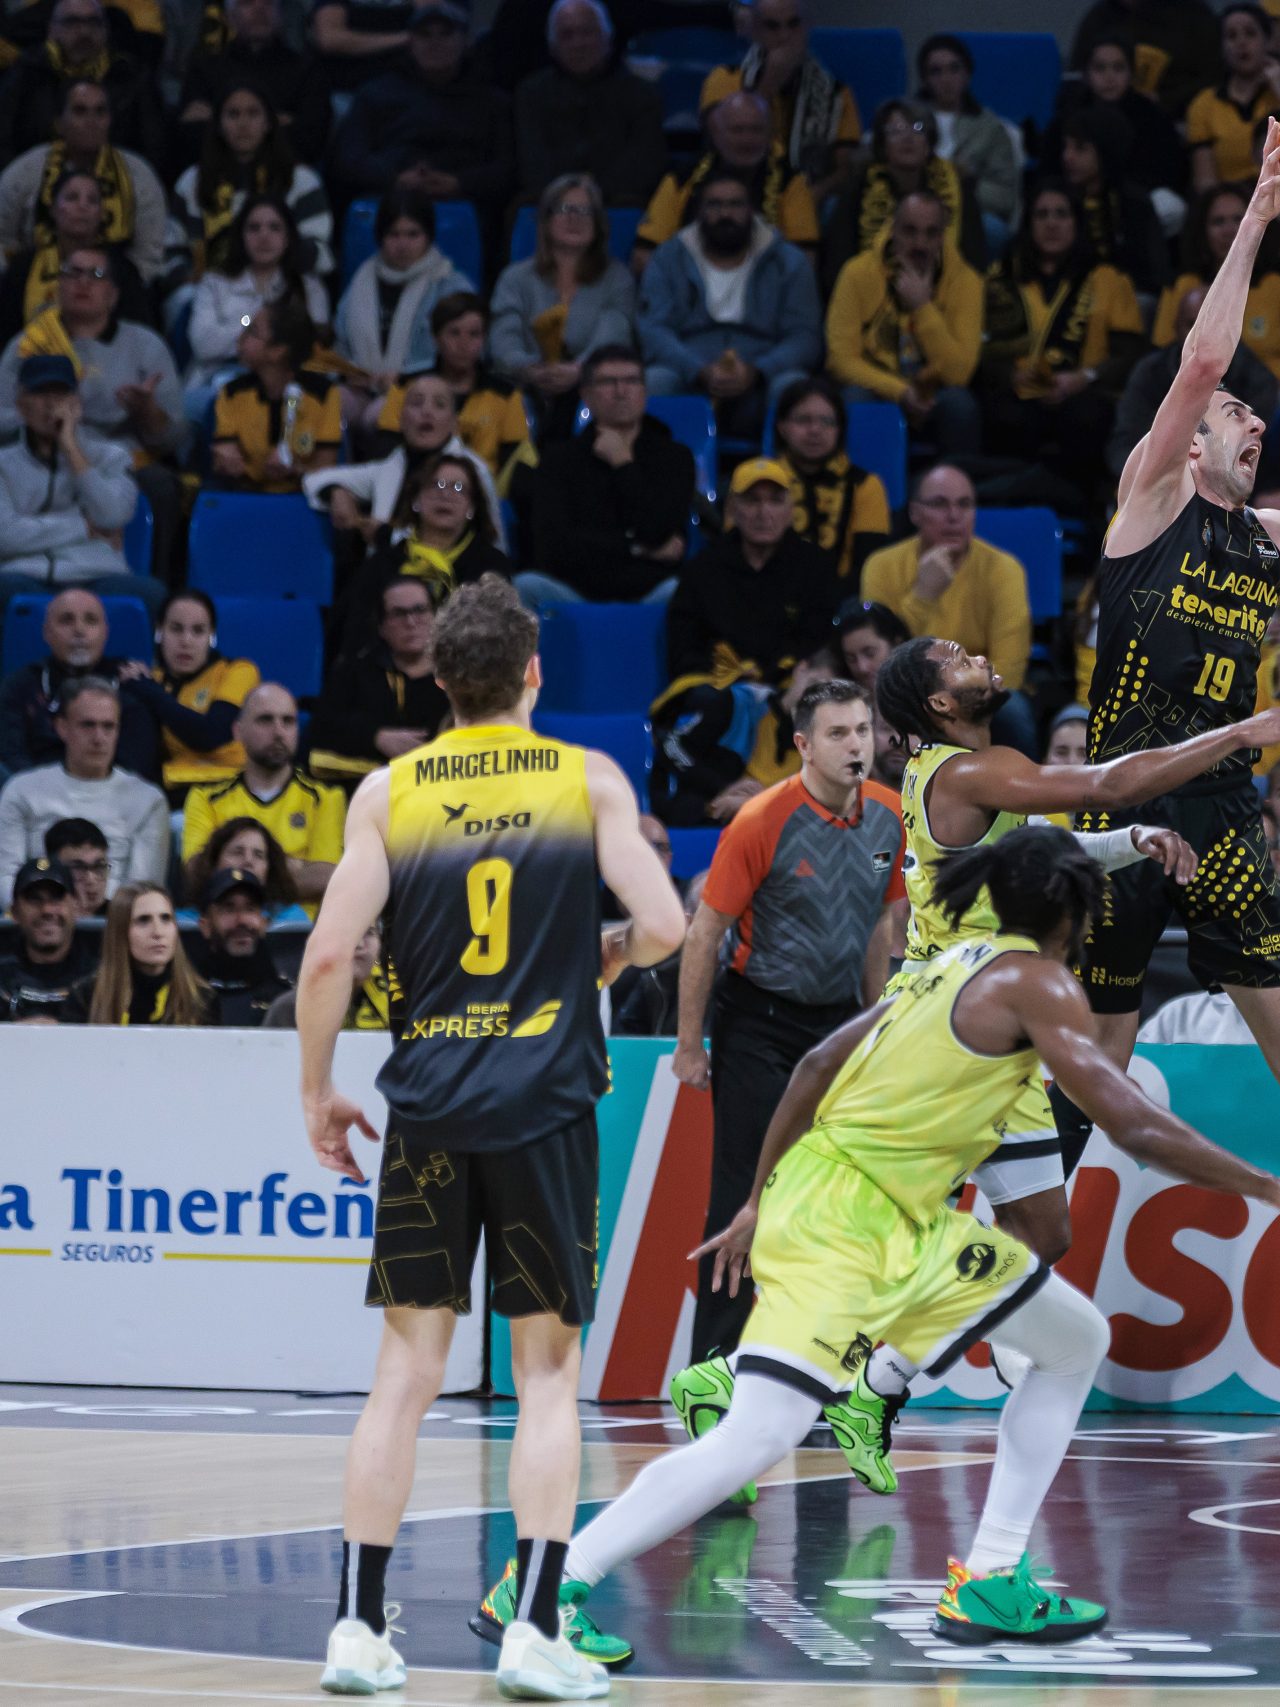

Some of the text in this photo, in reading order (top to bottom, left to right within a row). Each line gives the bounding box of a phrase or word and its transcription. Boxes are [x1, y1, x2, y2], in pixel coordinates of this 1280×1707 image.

[1180, 552, 1279, 607] LA LAGUNA
[1166, 609, 1215, 632] despierta
[1193, 652, 1236, 702] 19
[415, 748, 559, 787] MARCELINHO
[459, 856, 513, 976] 9
[466, 1002, 511, 1015] IBERIA
[60, 1167, 375, 1239] Tinerfeñ
[60, 1242, 155, 1263] SEGUROS
